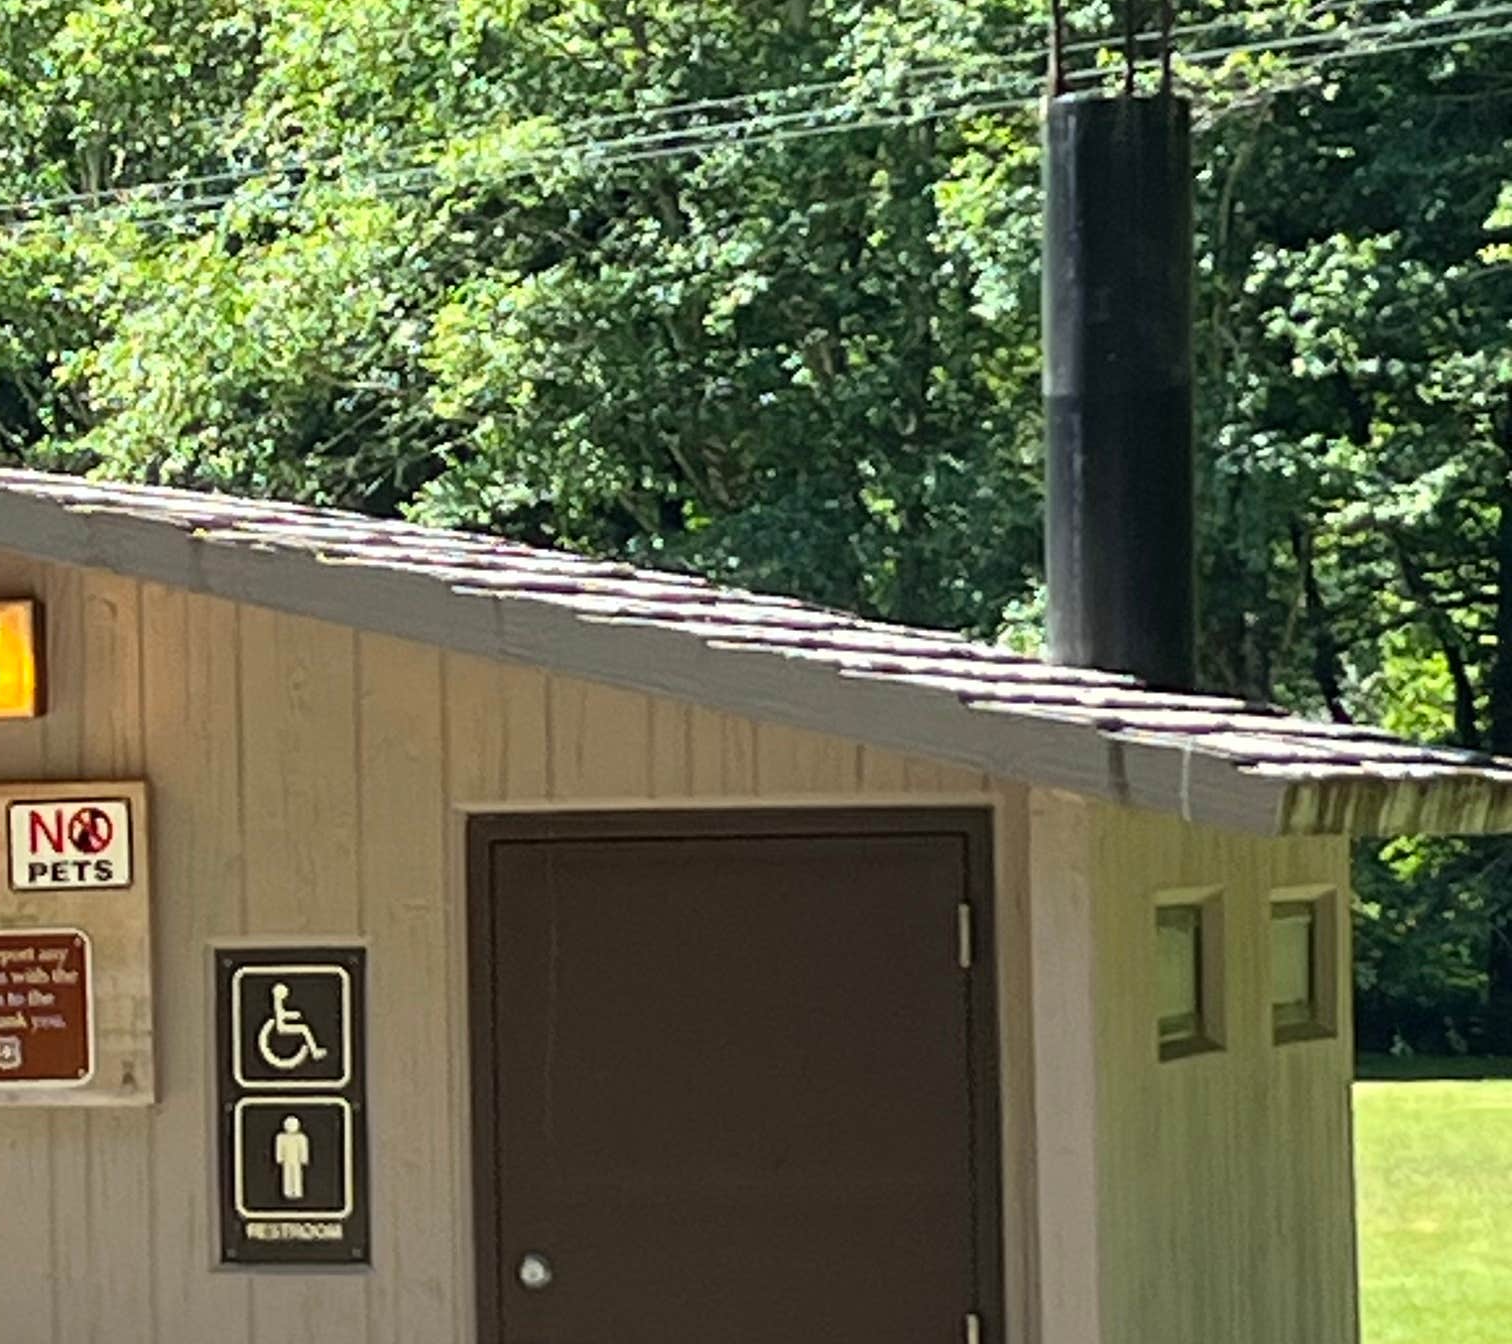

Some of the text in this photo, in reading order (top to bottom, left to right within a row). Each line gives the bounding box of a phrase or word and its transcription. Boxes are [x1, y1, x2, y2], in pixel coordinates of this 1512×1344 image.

[28, 860, 113, 883] PETS
[38, 948, 69, 969] any
[10, 967, 50, 985] with
[52, 968, 79, 985] the
[7, 991, 26, 1007] to
[28, 989, 56, 1007] the
[247, 1222, 343, 1239] RESTROOM
